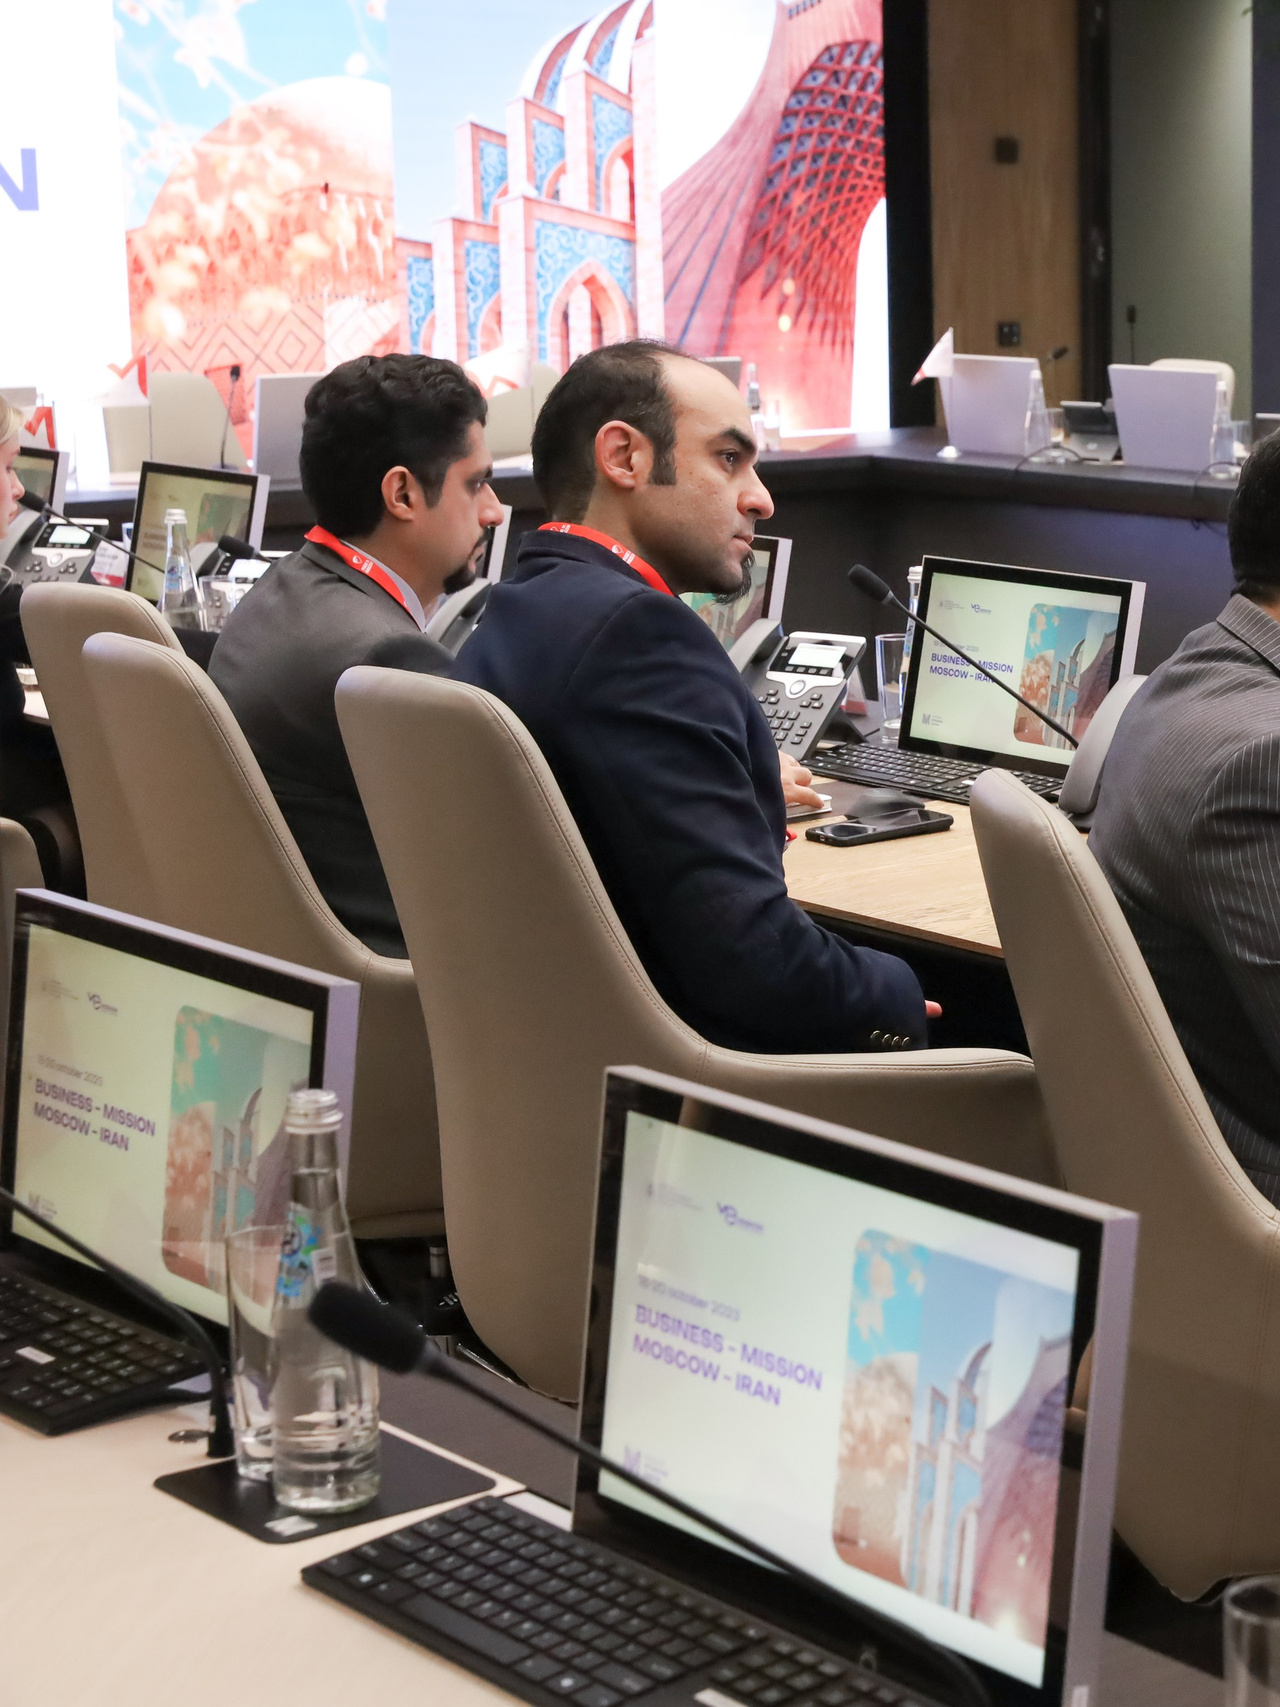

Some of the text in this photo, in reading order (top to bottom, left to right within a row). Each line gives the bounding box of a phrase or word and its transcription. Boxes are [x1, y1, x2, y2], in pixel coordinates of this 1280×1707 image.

[929, 665, 969, 679] MOSCOW
[33, 1101, 91, 1136] MOSCOW
[99, 1126, 130, 1152] IRAN
[35, 1078, 93, 1113] BUSINESS
[103, 1103, 156, 1137] MISSION
[632, 1333, 720, 1382] MOSCOW
[735, 1372, 781, 1406] IRAN
[635, 1303, 724, 1353] BUSINESS
[740, 1343, 823, 1391] MISSION
